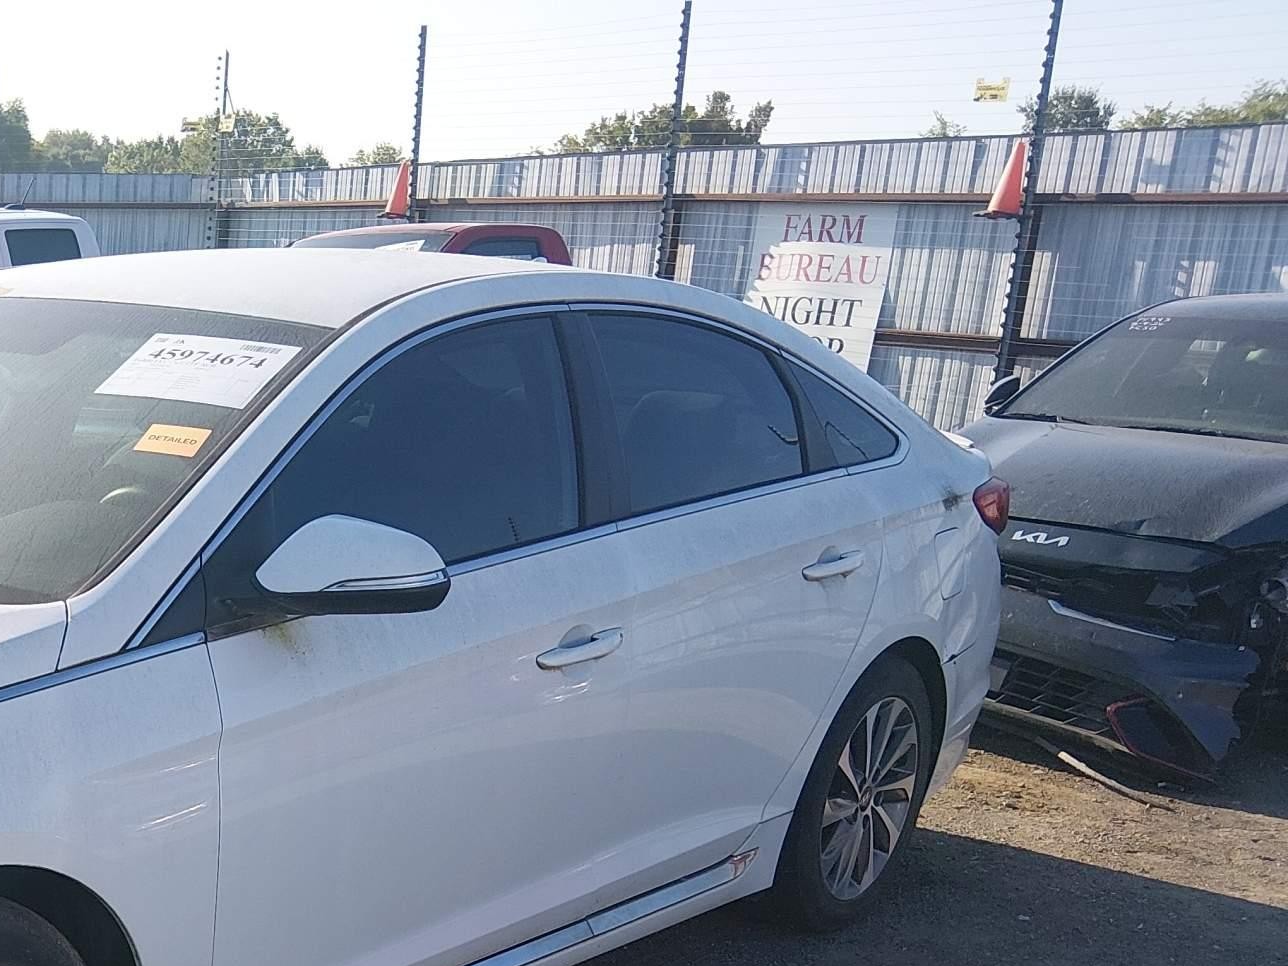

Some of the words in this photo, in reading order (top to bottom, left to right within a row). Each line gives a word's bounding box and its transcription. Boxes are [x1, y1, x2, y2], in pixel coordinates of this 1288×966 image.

[782, 214, 867, 244] FARM
[757, 253, 881, 284] BUREAU
[760, 295, 863, 328] NIGHT
[148, 347, 268, 369] 45974674
[147, 434, 198, 446] DETAILED
